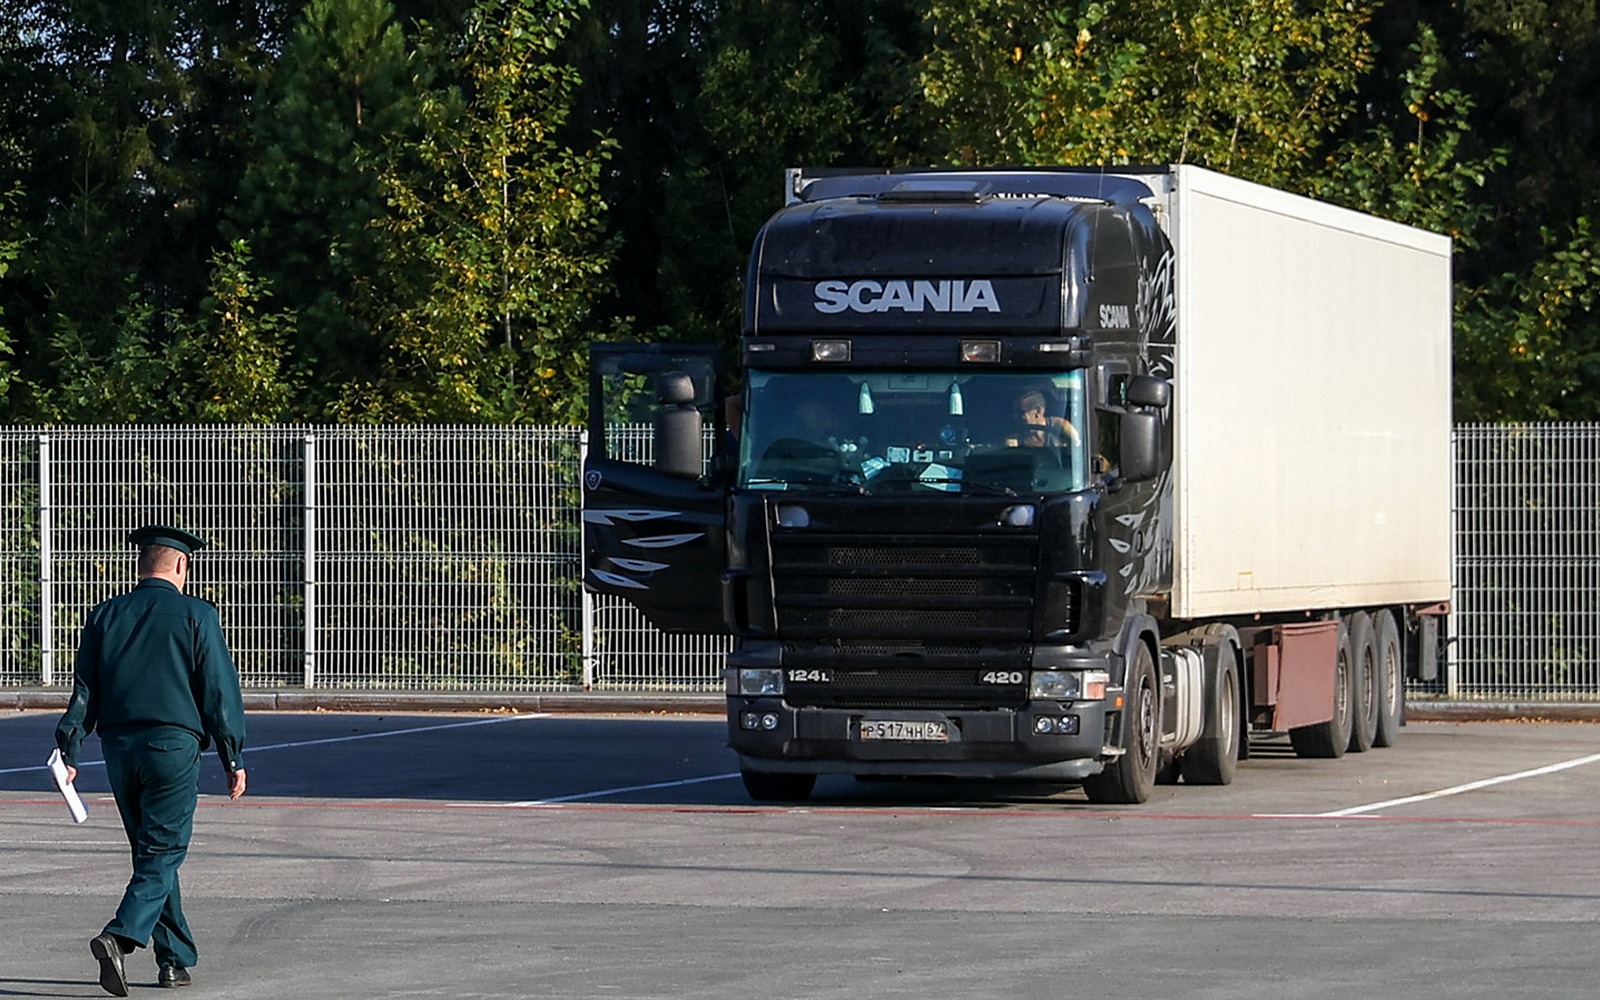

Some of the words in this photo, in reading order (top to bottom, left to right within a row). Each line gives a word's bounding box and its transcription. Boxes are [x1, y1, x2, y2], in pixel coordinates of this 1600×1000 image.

[814, 280, 1001, 314] SCANIA
[1099, 304, 1130, 329] SCANIA
[983, 671, 1023, 684] 420
